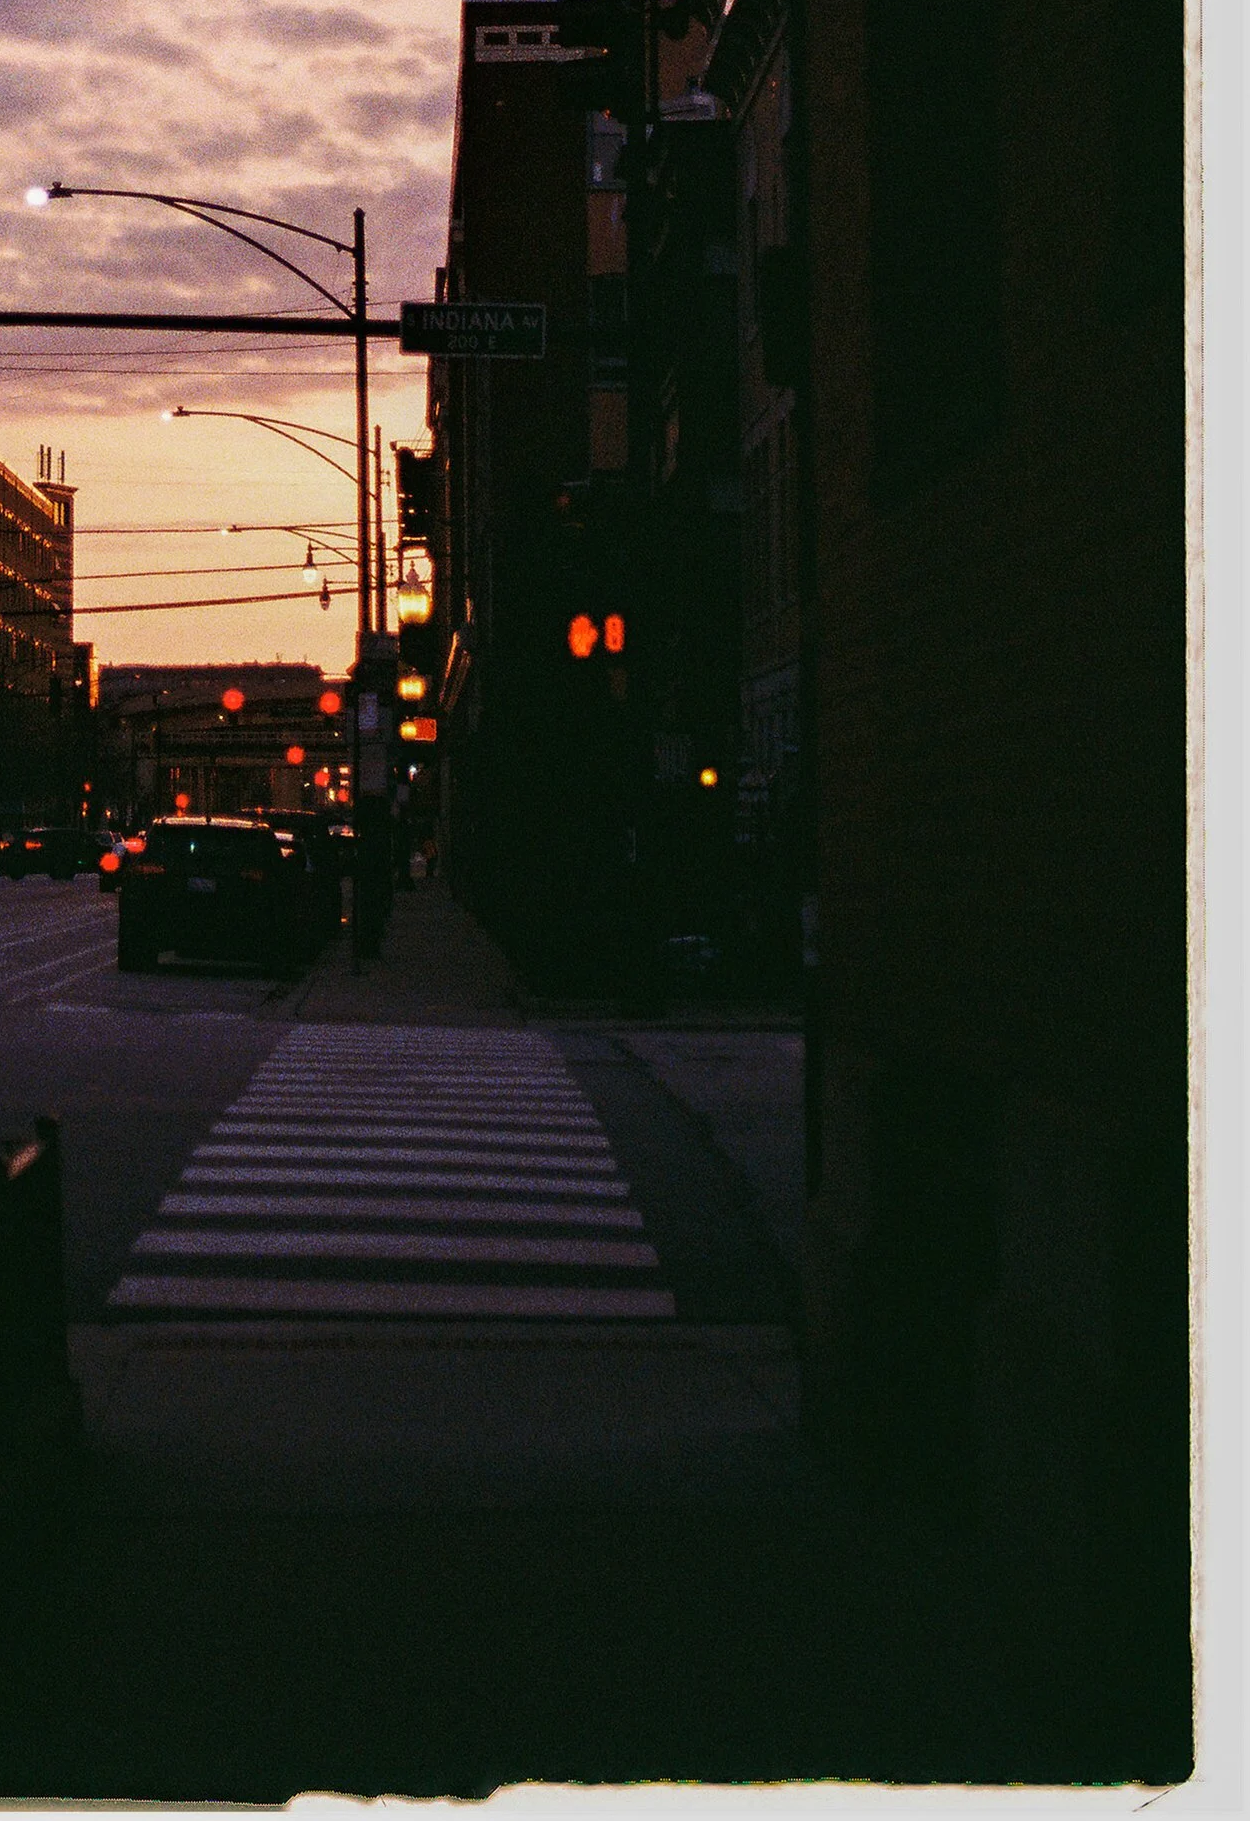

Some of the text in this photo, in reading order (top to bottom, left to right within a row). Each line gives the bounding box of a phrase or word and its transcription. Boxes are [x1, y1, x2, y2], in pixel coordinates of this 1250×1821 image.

[421, 310, 515, 331] INDIANA
[447, 334, 498, 350] 200 E
